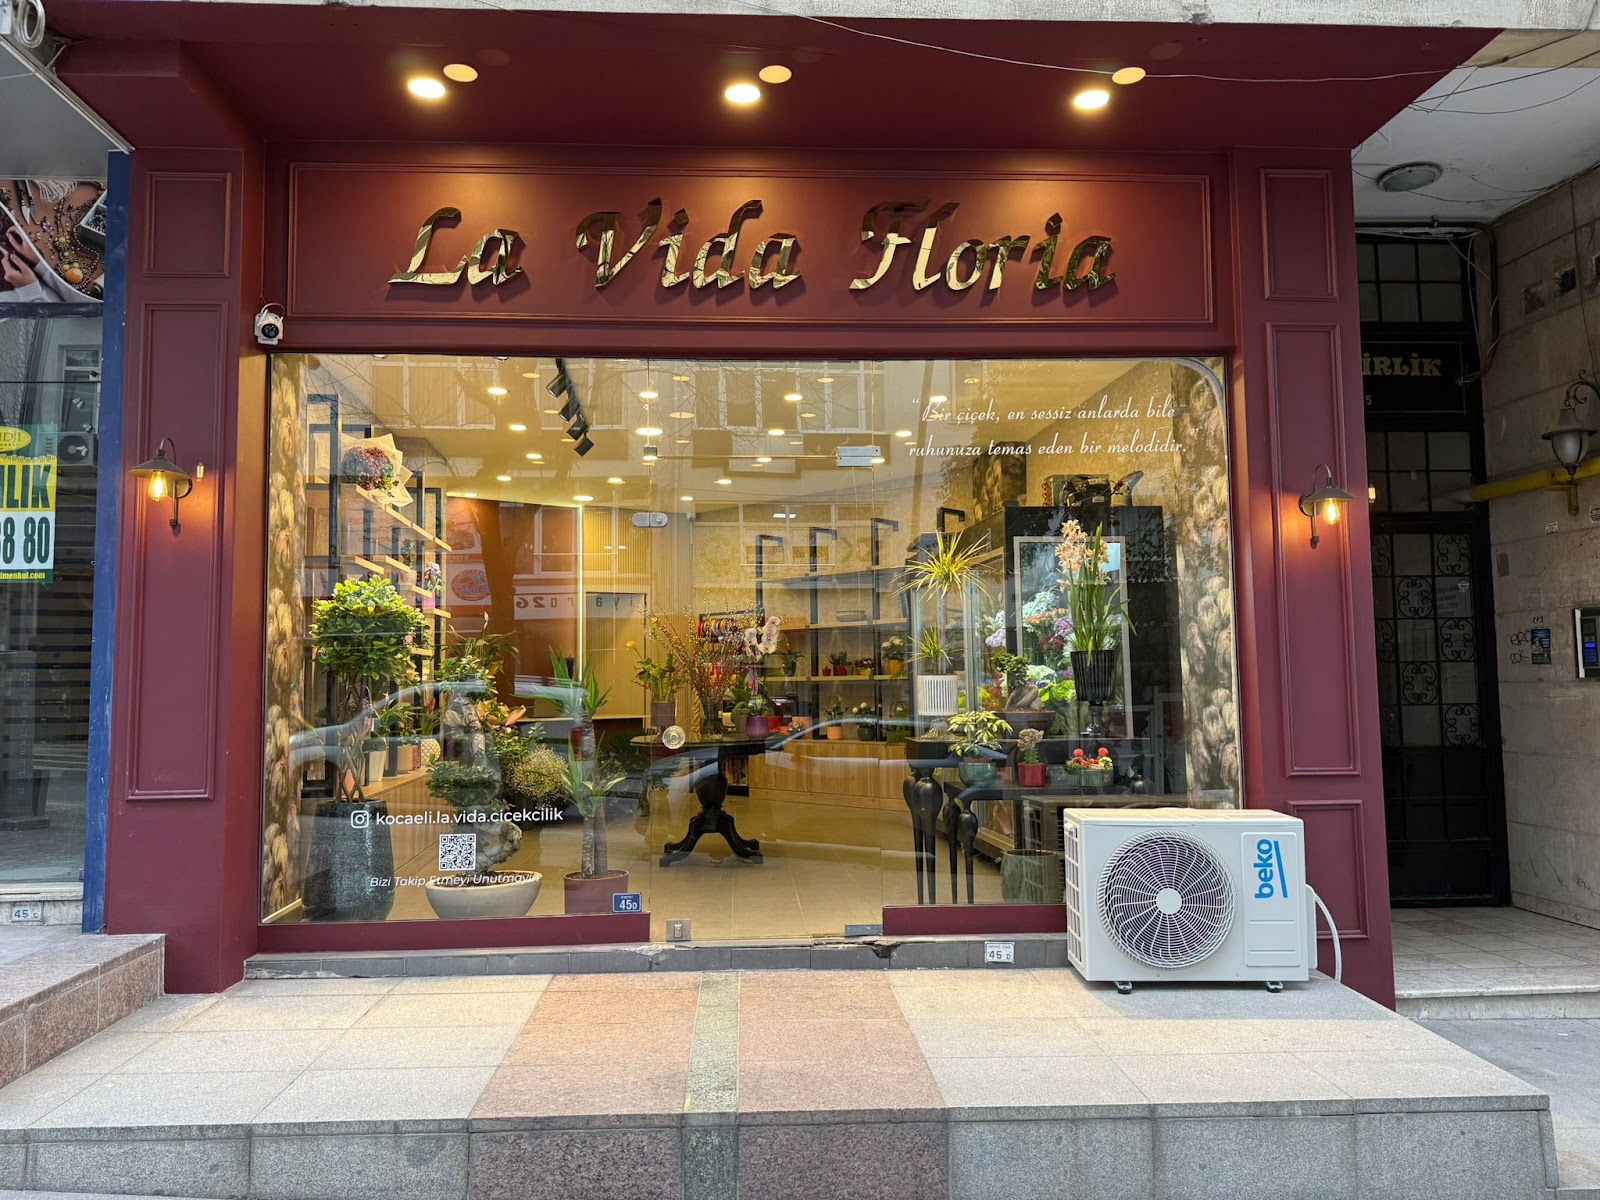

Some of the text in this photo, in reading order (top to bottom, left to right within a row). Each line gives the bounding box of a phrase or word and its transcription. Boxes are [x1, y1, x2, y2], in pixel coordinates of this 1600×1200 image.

[388, 197, 1117, 292] La Vida Floria
[957, 398, 1000, 425] çiçek,
[1007, 411, 1026, 421] en
[1031, 406, 1072, 420] sessiz
[1077, 394, 1140, 419] anlarda
[1146, 393, 1176, 419] bile
[908, 434, 982, 456] ruhunuza
[988, 440, 1032, 456] temas
[1037, 432, 1074, 455] eden
[1080, 431, 1102, 454] bir
[23, 516, 50, 565] 80
[376, 807, 563, 826] kocaeli.la.vida.cicekcilik
[1253, 838, 1275, 898] beko
[370, 876, 391, 887] Bizi
[394, 876, 426, 888] Takip
[429, 875, 471, 887] Etmeyi
[14, 909, 29, 918] 45
[989, 950, 1002, 960] 45
